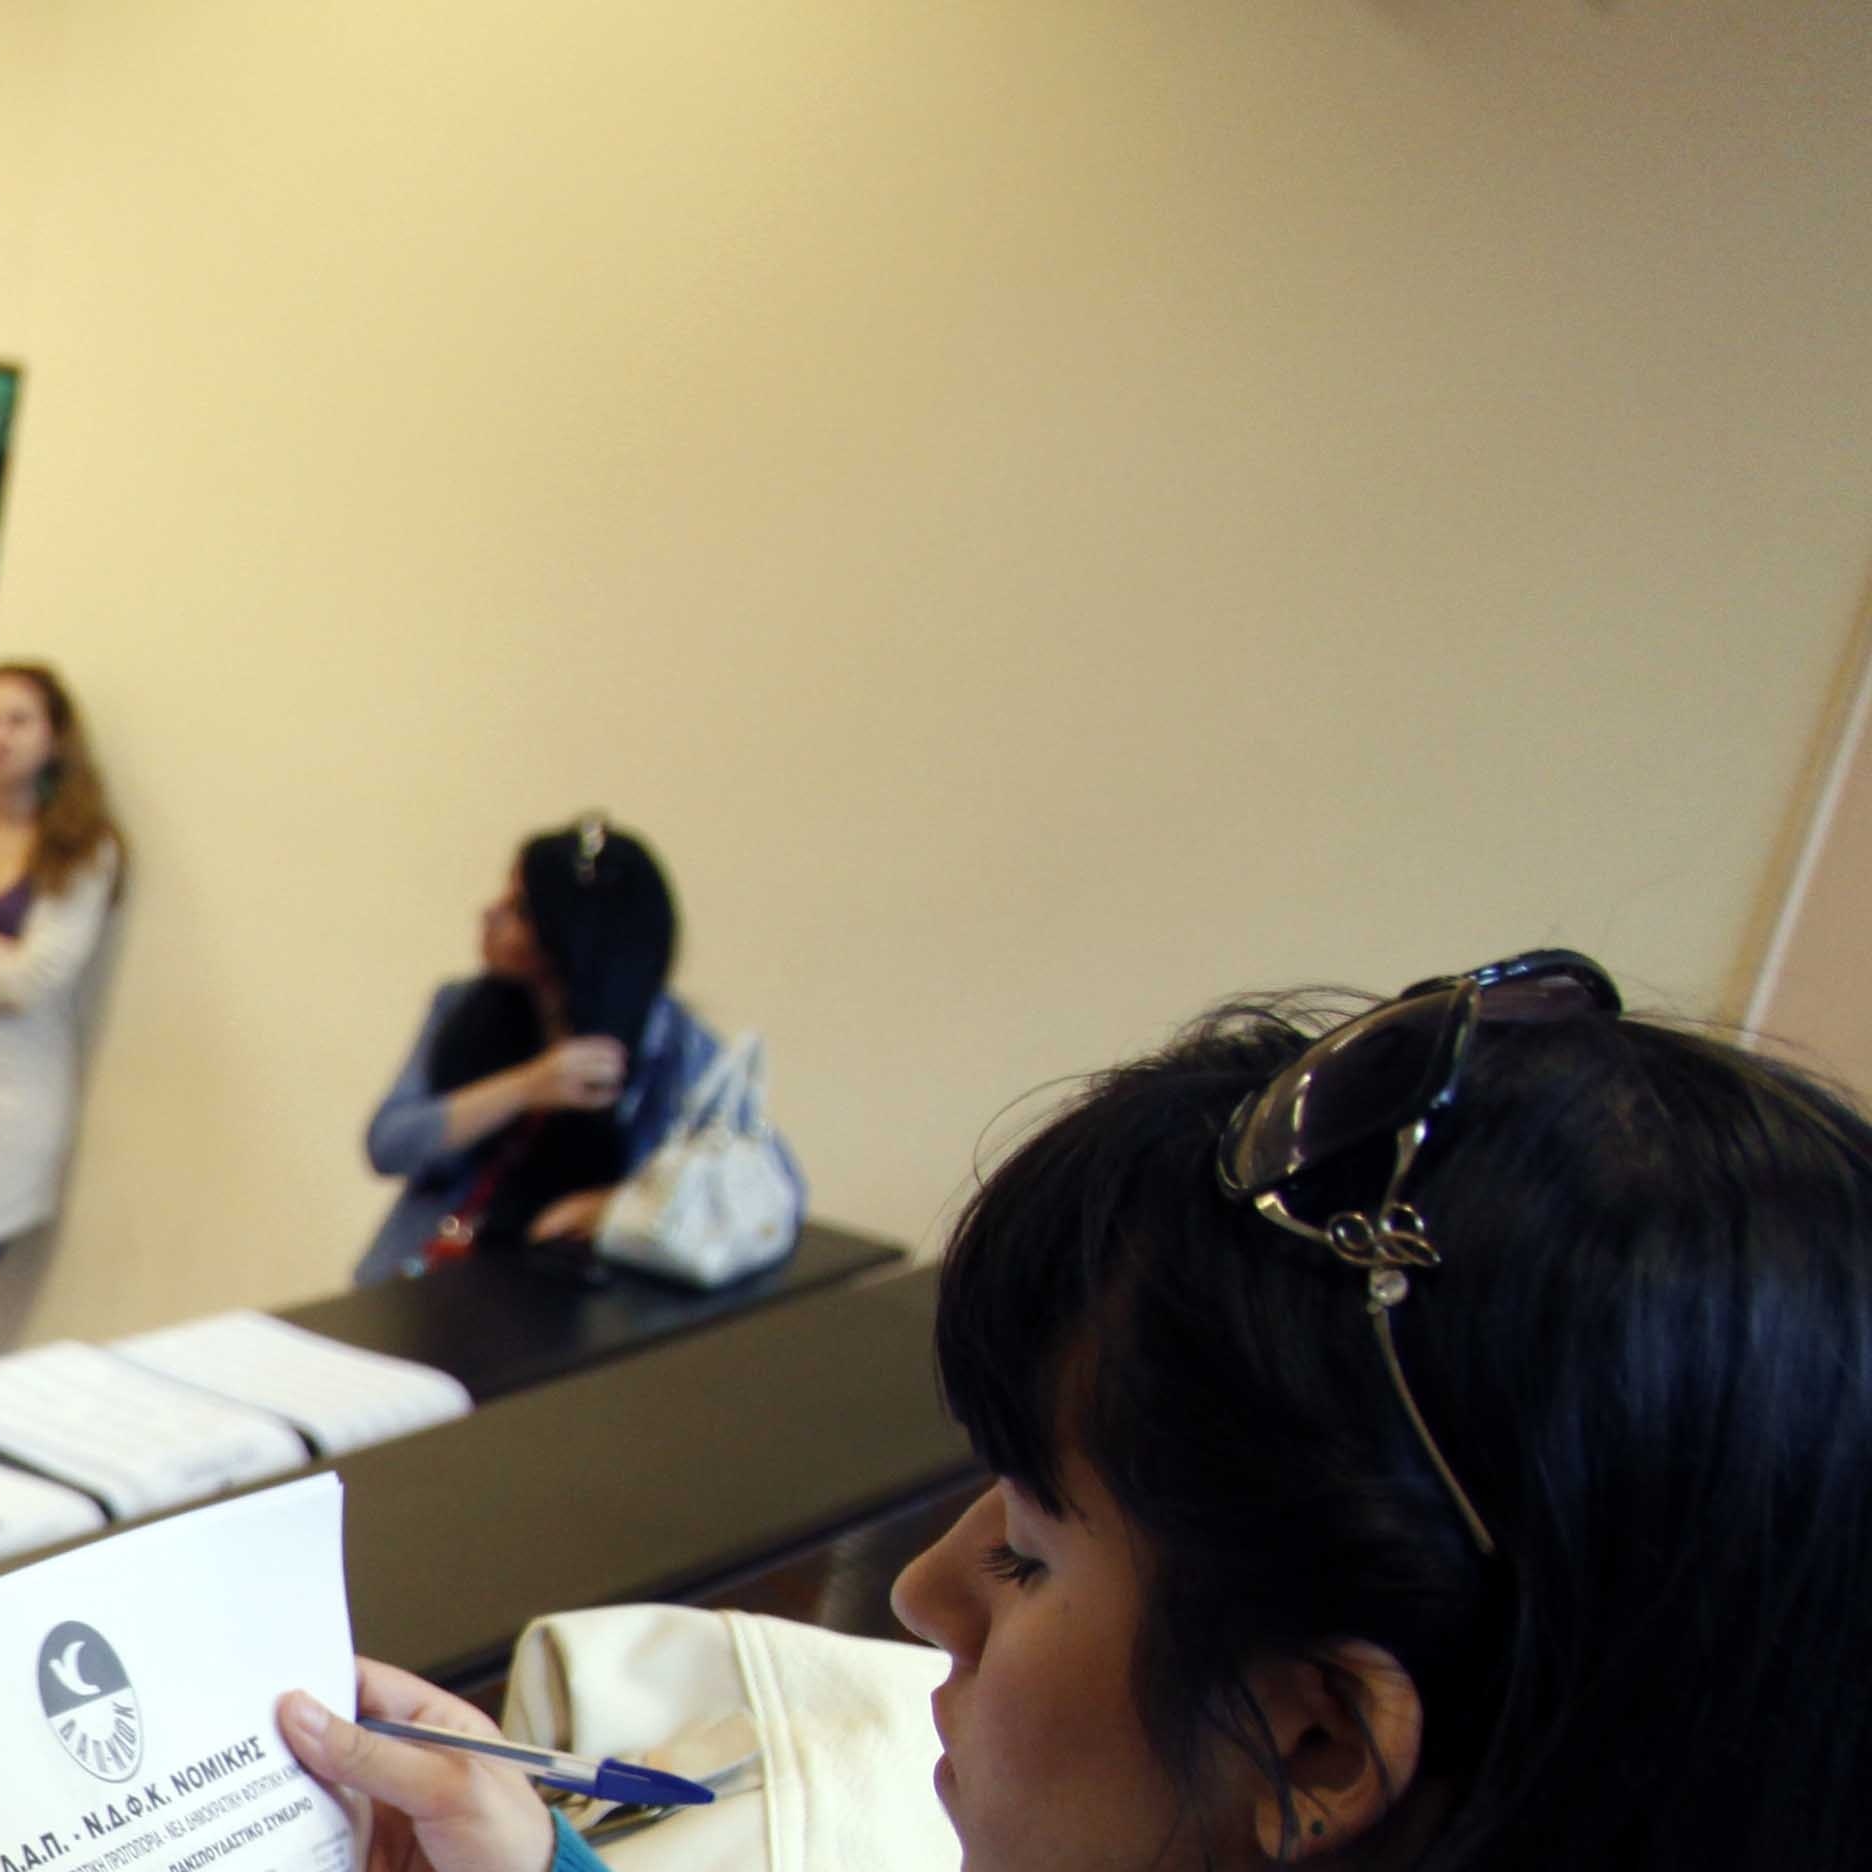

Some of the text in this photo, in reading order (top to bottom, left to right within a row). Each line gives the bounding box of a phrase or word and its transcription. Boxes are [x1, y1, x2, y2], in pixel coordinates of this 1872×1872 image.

[81, 1783, 172, 1839] Ν.Δ.Φ.Κ.
[170, 1735, 266, 1797] ΝΟΜΙΚΗΣ
[262, 1796, 313, 1832] ΣΥΝΕΔΡΙΟ
